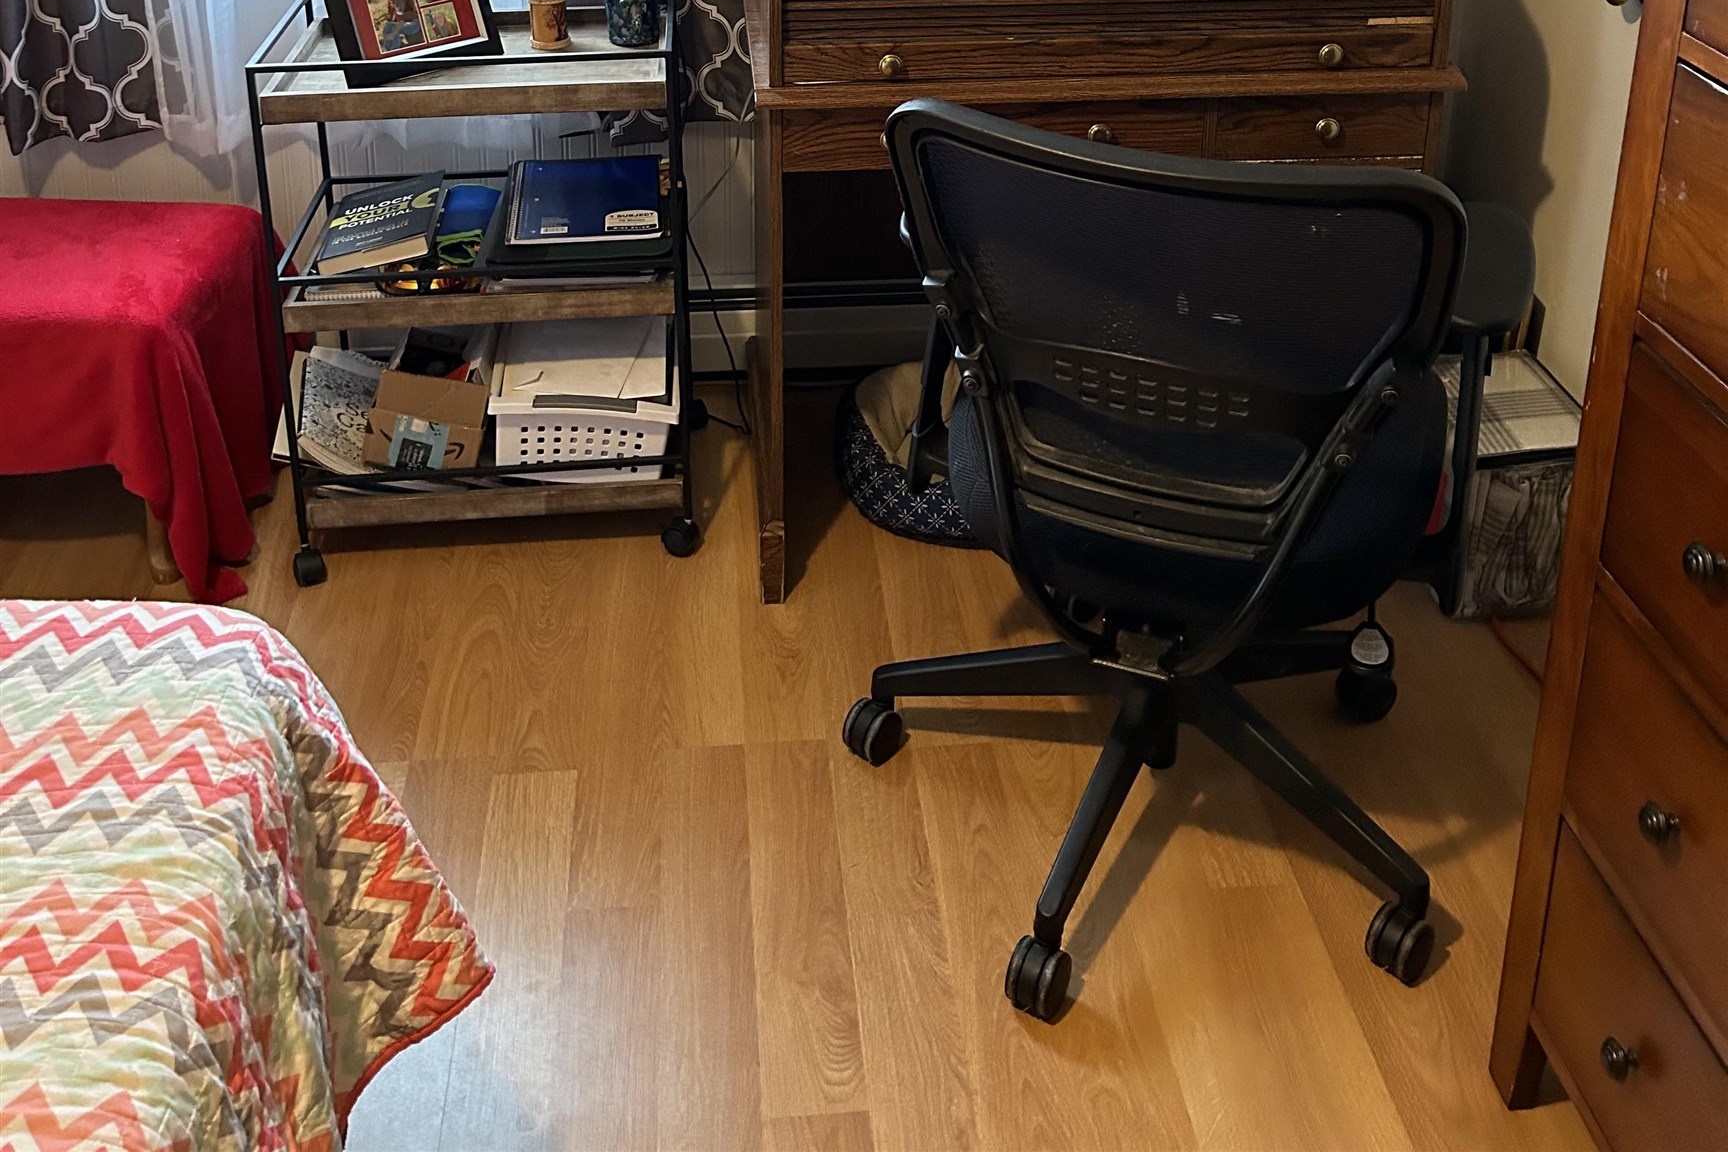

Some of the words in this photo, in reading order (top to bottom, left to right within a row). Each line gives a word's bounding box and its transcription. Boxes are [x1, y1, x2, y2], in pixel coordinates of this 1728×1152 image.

[344, 193, 414, 215] UNLOCK
[345, 204, 401, 222] YOUR
[338, 208, 414, 230] POTENTIAL
